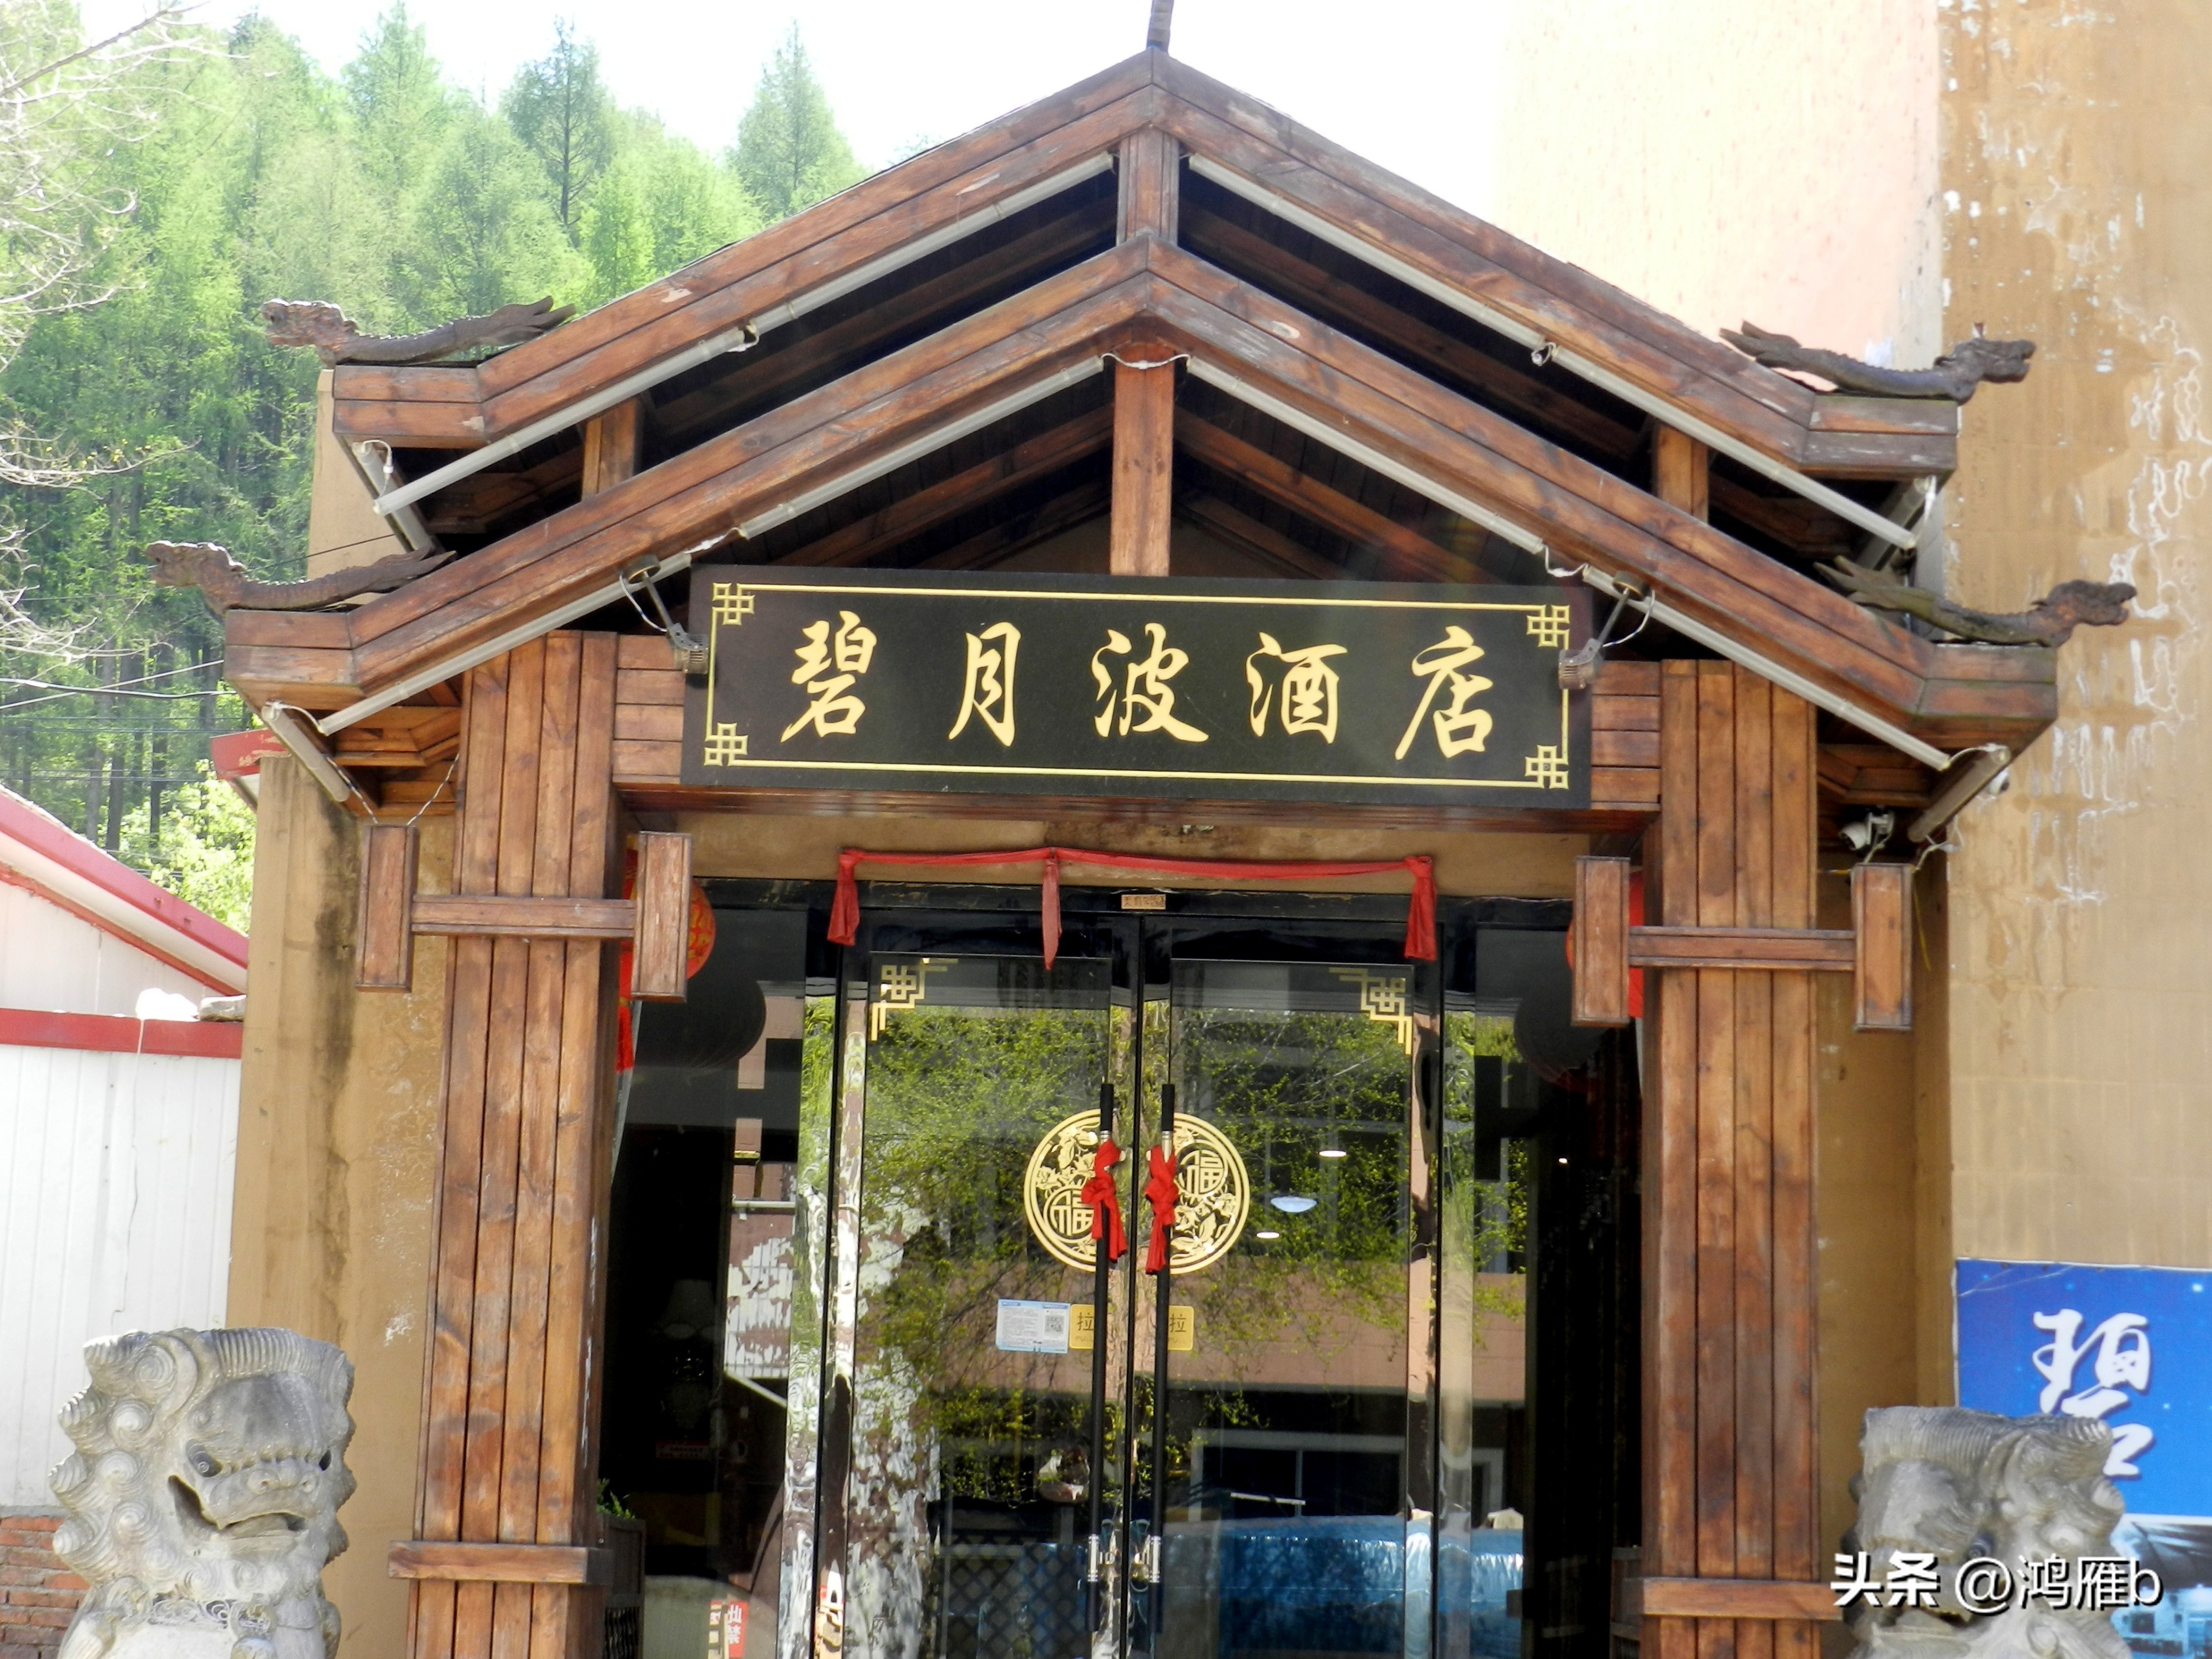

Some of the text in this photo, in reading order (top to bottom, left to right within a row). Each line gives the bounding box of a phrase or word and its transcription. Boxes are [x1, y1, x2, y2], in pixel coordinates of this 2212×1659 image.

[779, 610, 1495, 760] 碧月波酒店
[1180, 1149, 1225, 1196] 福
[1077, 1312, 1094, 1331] 拉
[1169, 1313, 1187, 1332] 拉
